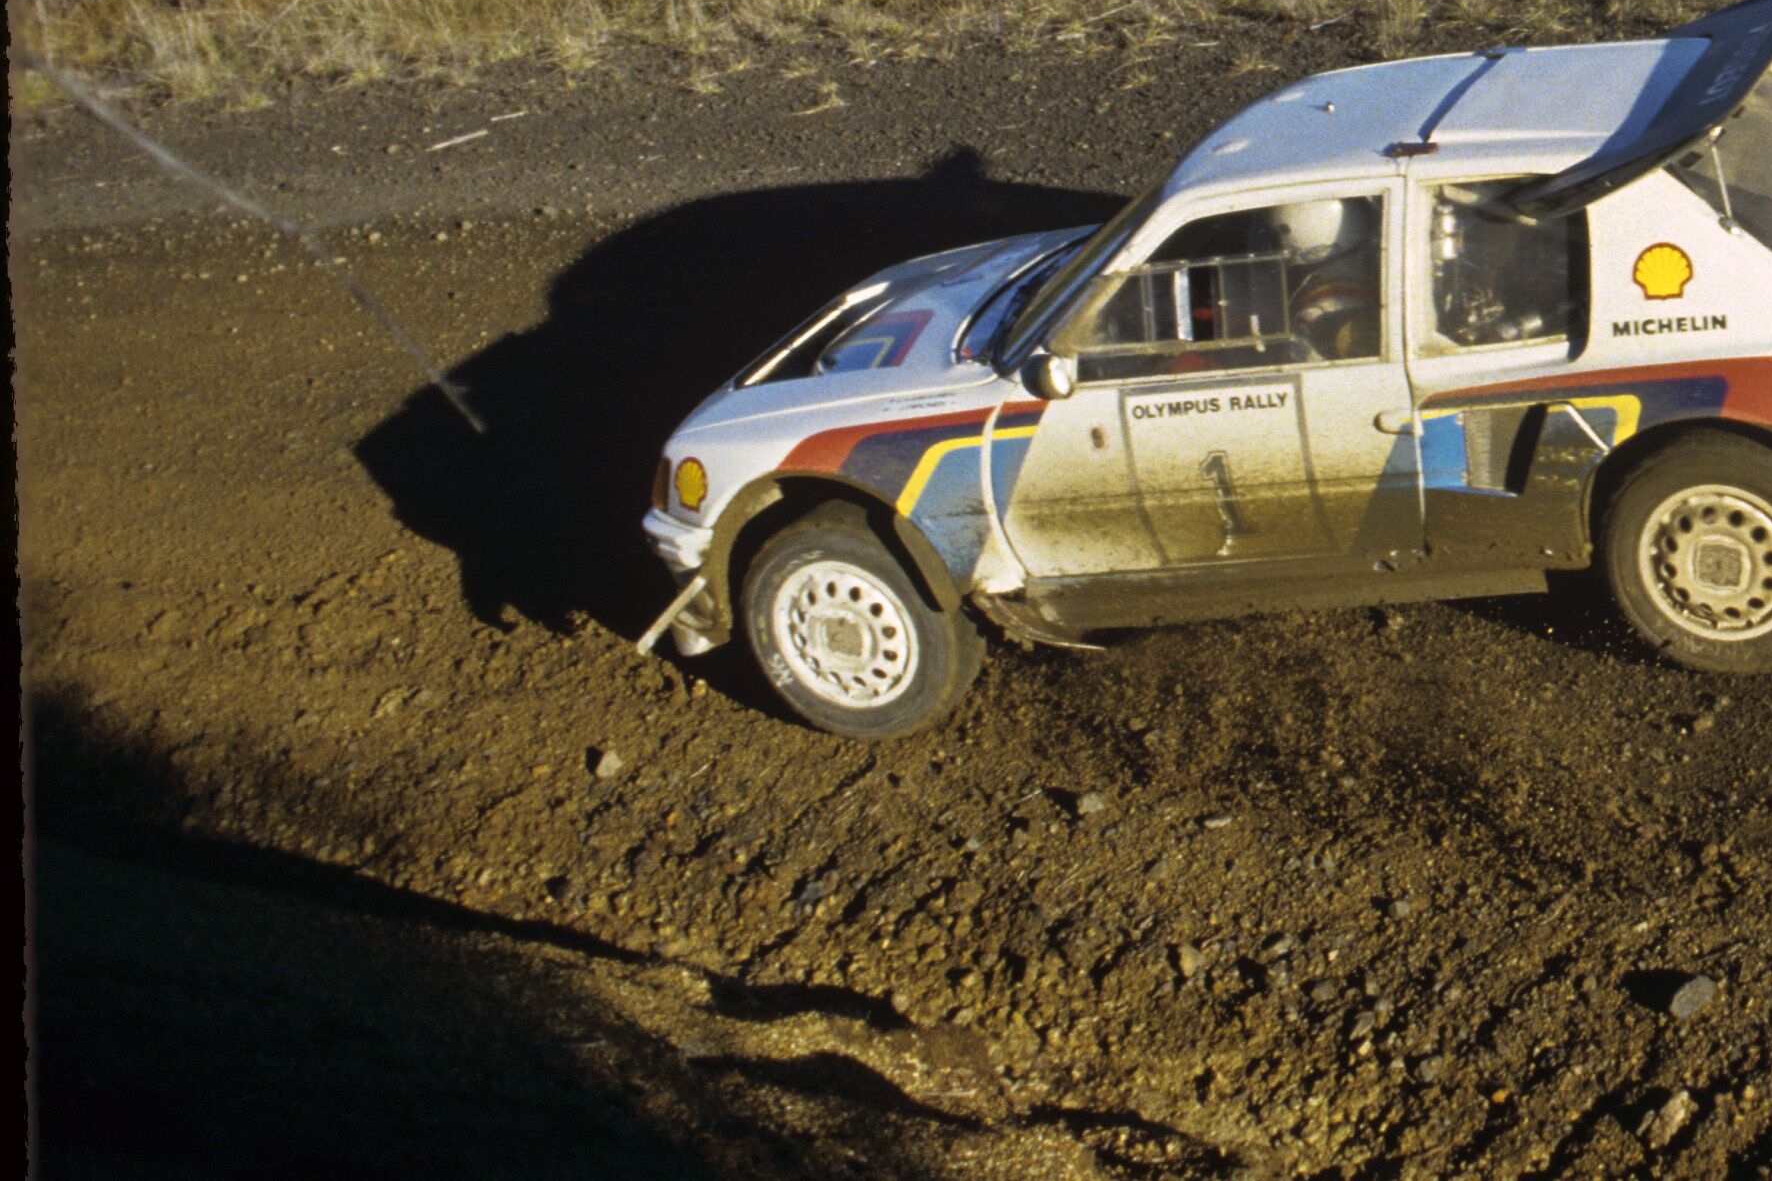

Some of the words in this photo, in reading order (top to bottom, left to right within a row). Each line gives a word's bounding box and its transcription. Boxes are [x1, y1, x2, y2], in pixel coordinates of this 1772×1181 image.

[1612, 314, 1728, 338] MICHELIN
[1132, 397, 1221, 420] OLYMPUS
[1230, 392, 1288, 411] RALLY
[1200, 450, 1260, 536] 1
